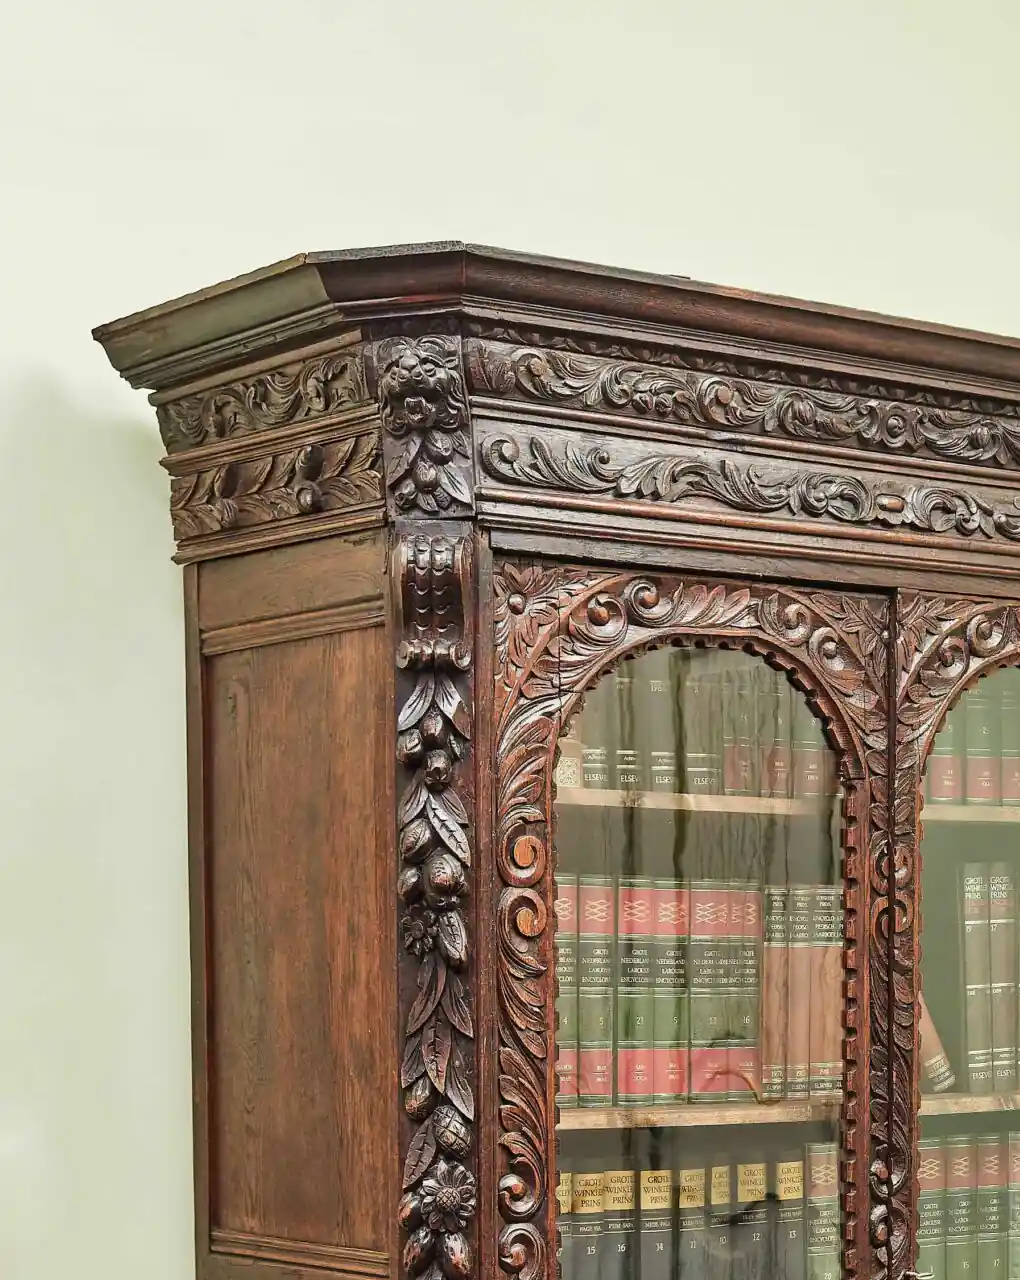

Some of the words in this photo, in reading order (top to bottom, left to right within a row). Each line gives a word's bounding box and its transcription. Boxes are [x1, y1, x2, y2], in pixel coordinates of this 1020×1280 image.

[581, 1199, 601, 1208] PRINS
[650, 1196, 668, 1204] PRINS
[752, 1232, 760, 1241] 12
[587, 1246, 596, 1255] 15
[617, 1243, 626, 1252] 16
